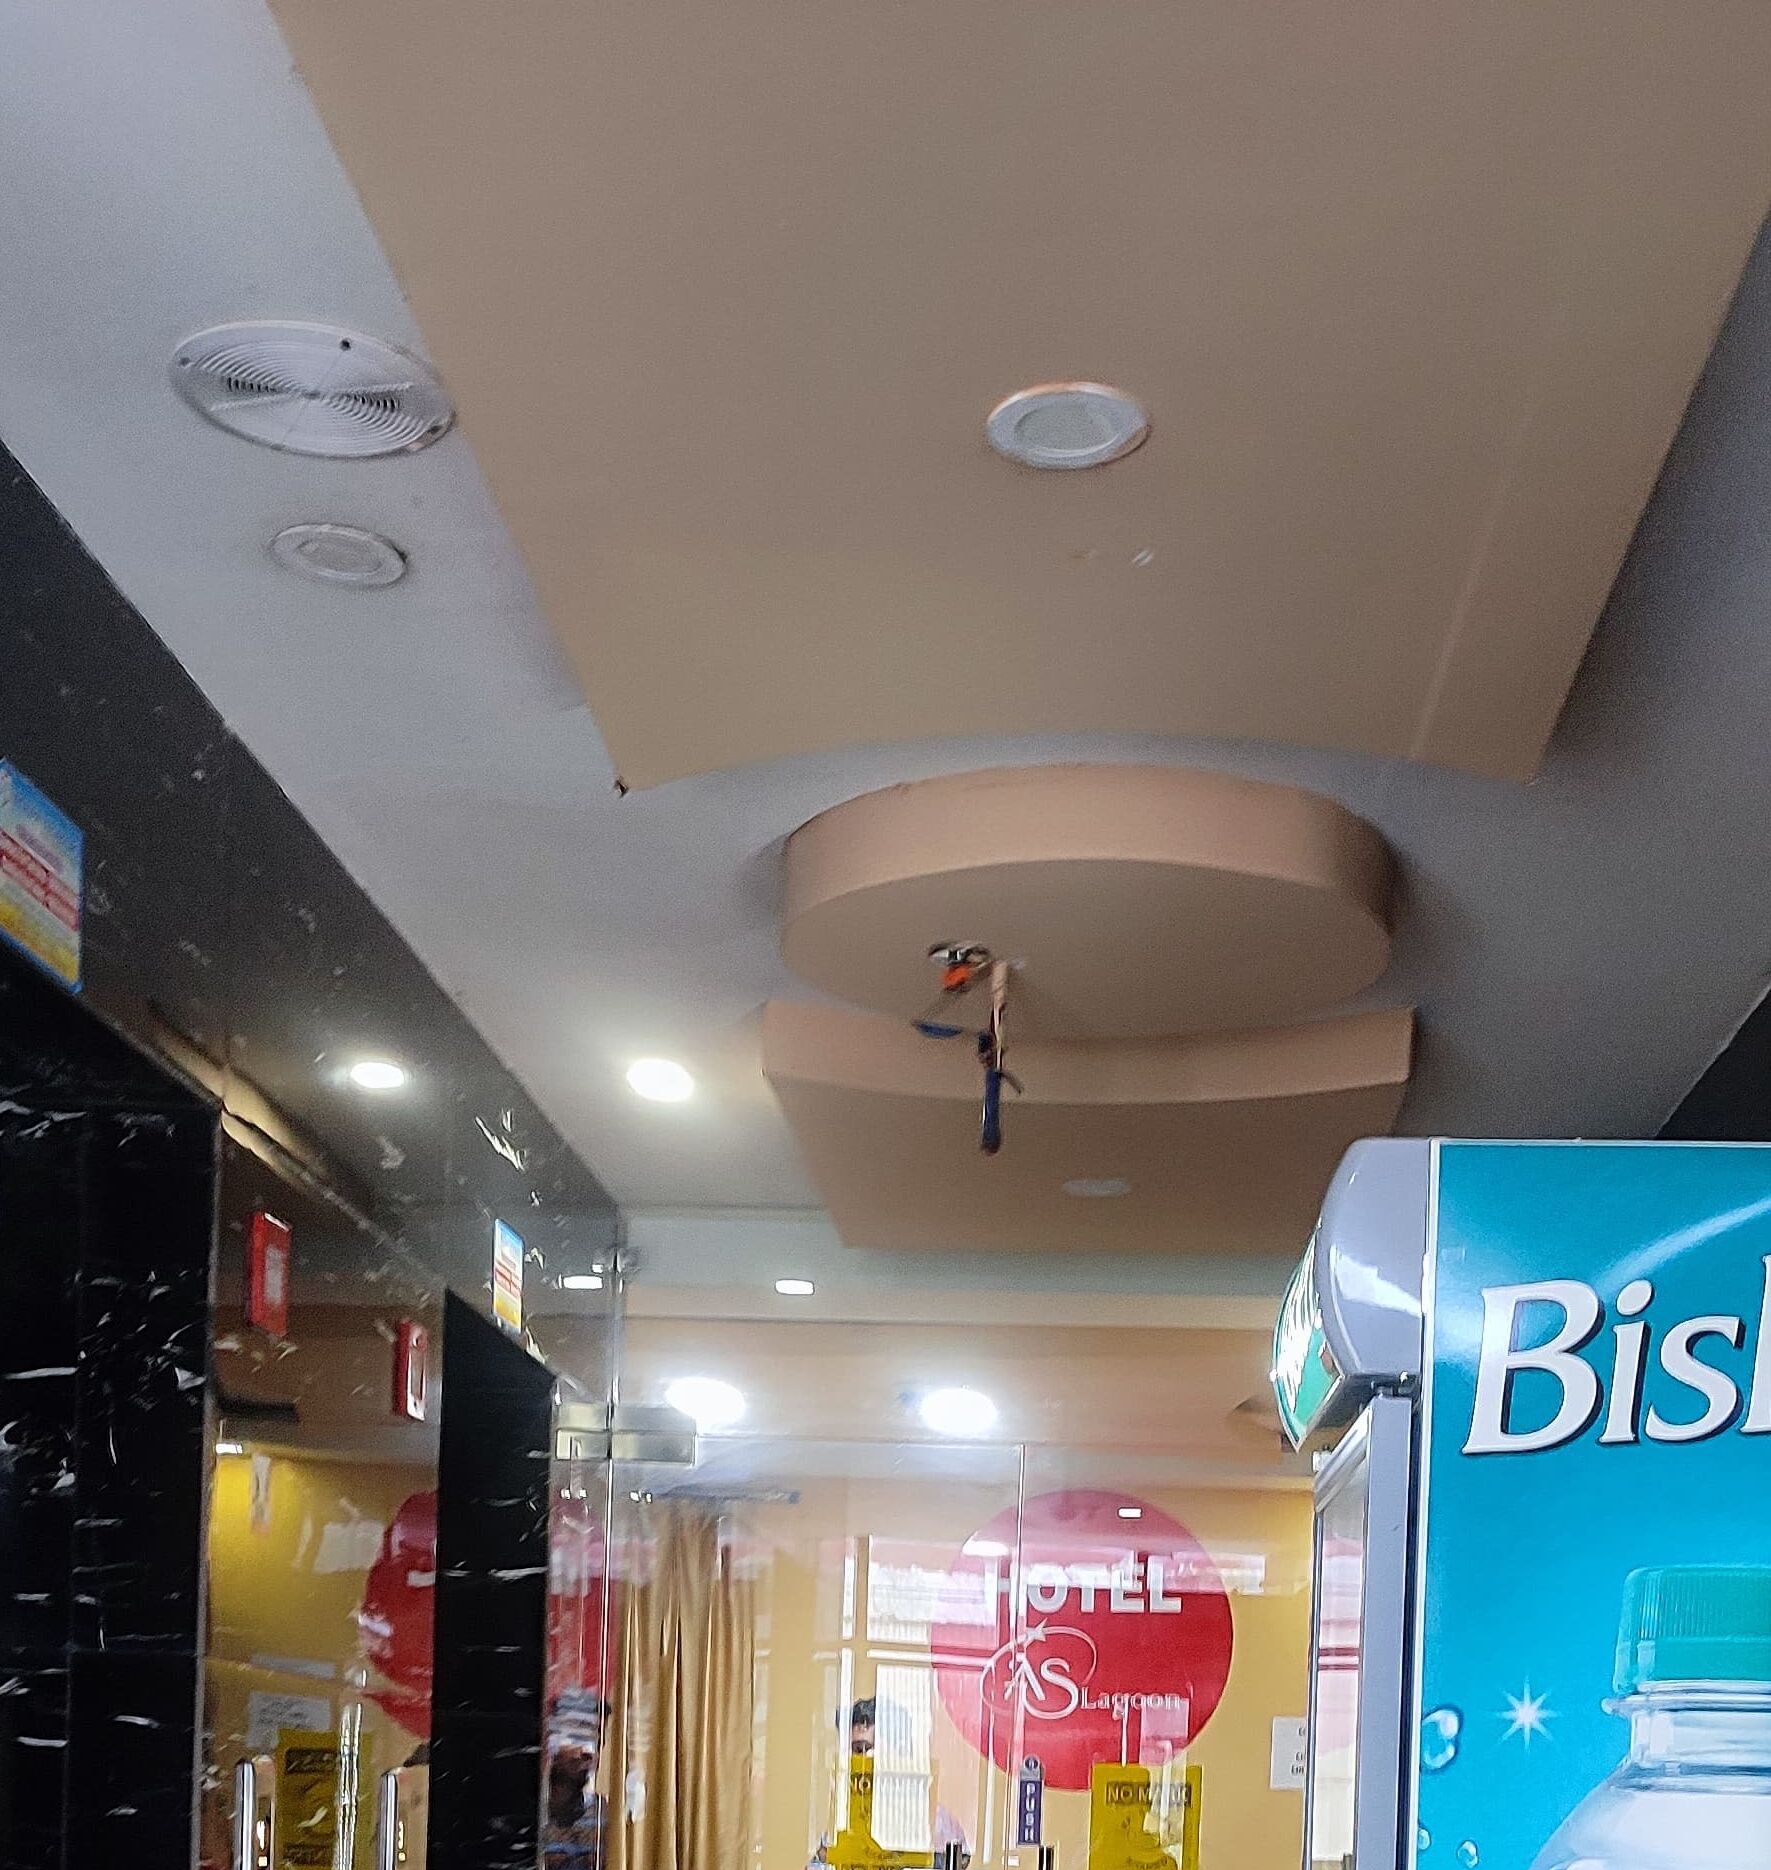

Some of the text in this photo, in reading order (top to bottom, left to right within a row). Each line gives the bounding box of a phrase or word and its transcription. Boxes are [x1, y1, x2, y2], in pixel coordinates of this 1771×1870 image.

[984, 1554, 1182, 1613] HOTEL
[1080, 1687, 1181, 1720] Lagoon
[1023, 1783, 1036, 1842] PUSH
[1107, 1784, 1133, 1805] NO
